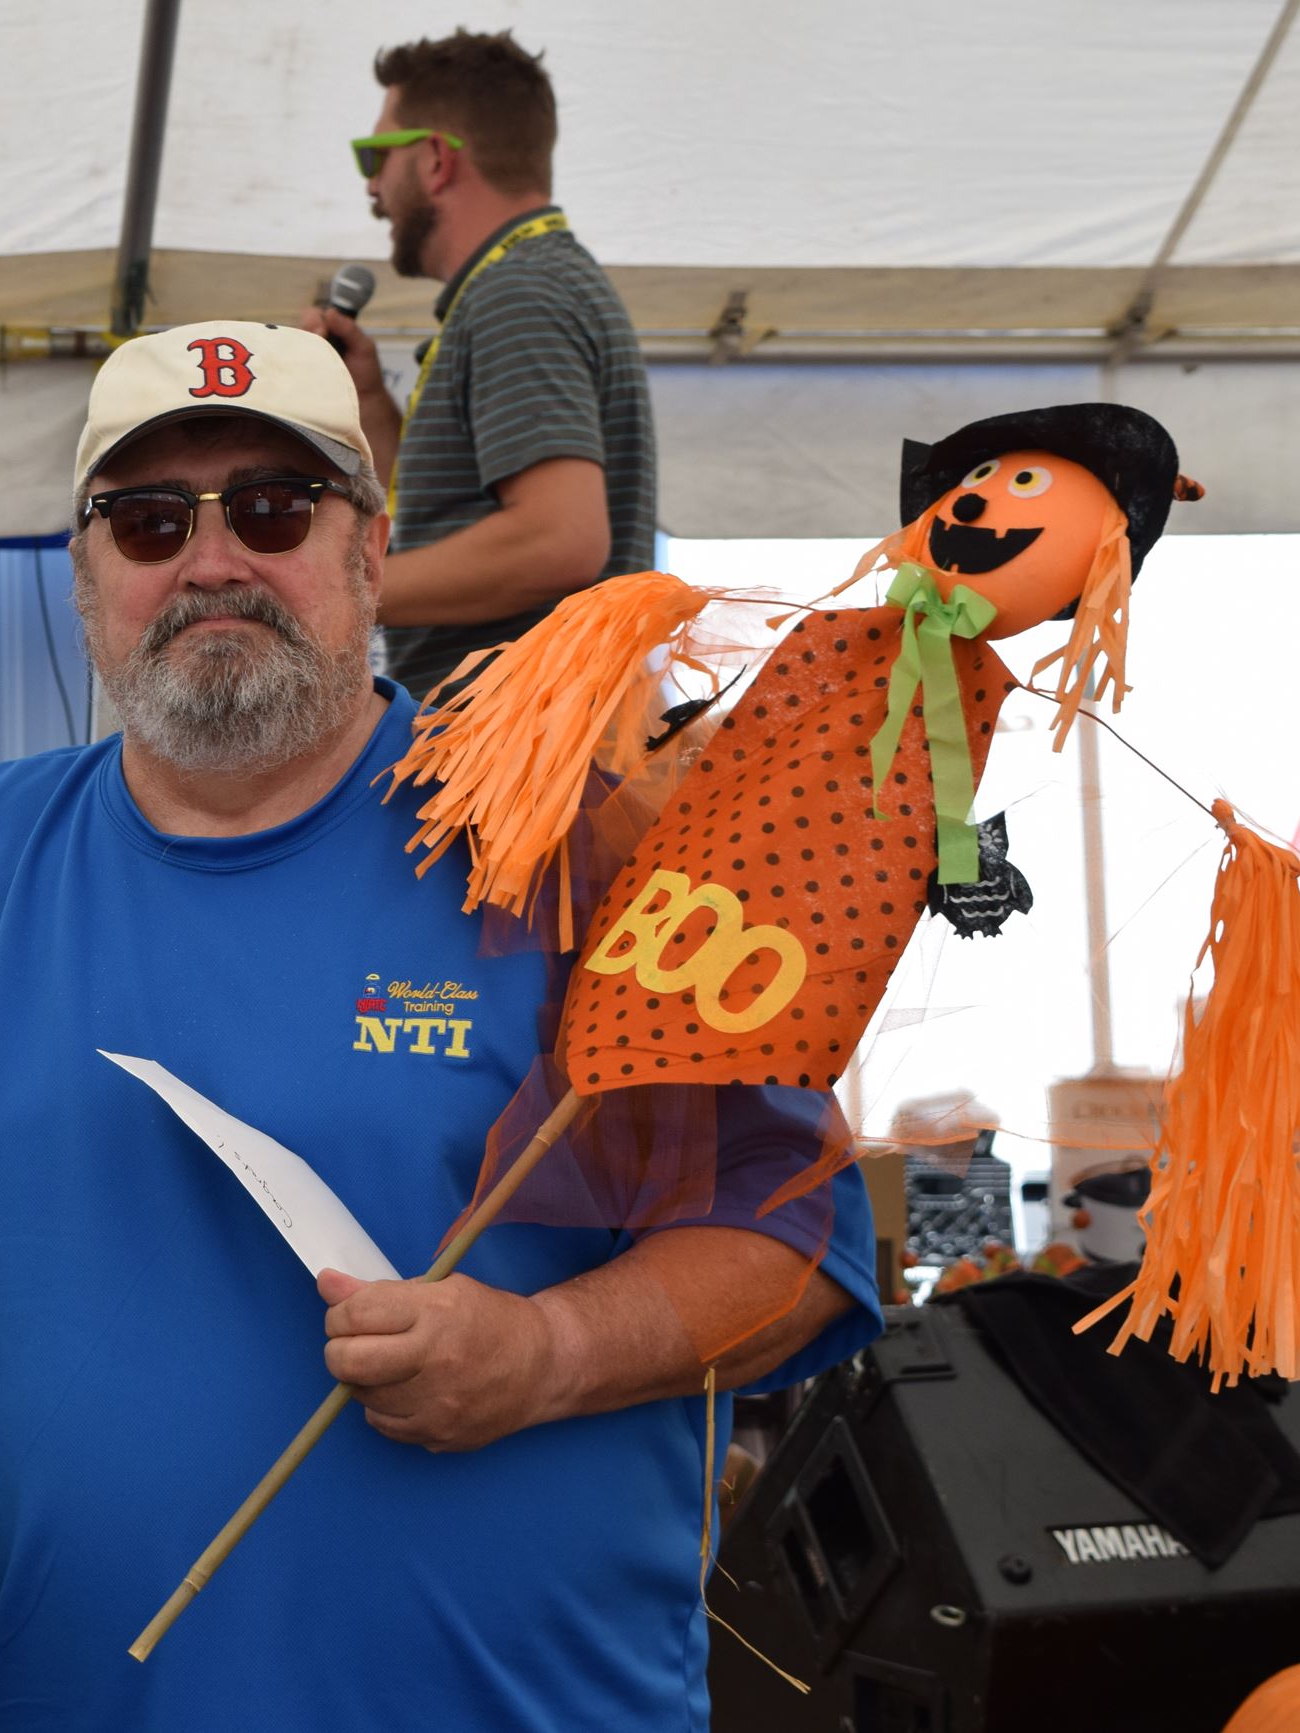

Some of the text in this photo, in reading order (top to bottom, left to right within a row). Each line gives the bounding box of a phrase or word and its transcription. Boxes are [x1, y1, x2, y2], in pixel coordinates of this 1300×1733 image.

[186, 336, 257, 398] B
[584, 868, 807, 1034] BOO
[387, 979, 479, 1000] World-Class
[403, 1000, 455, 1016] Training
[352, 1015, 473, 1058] NTI
